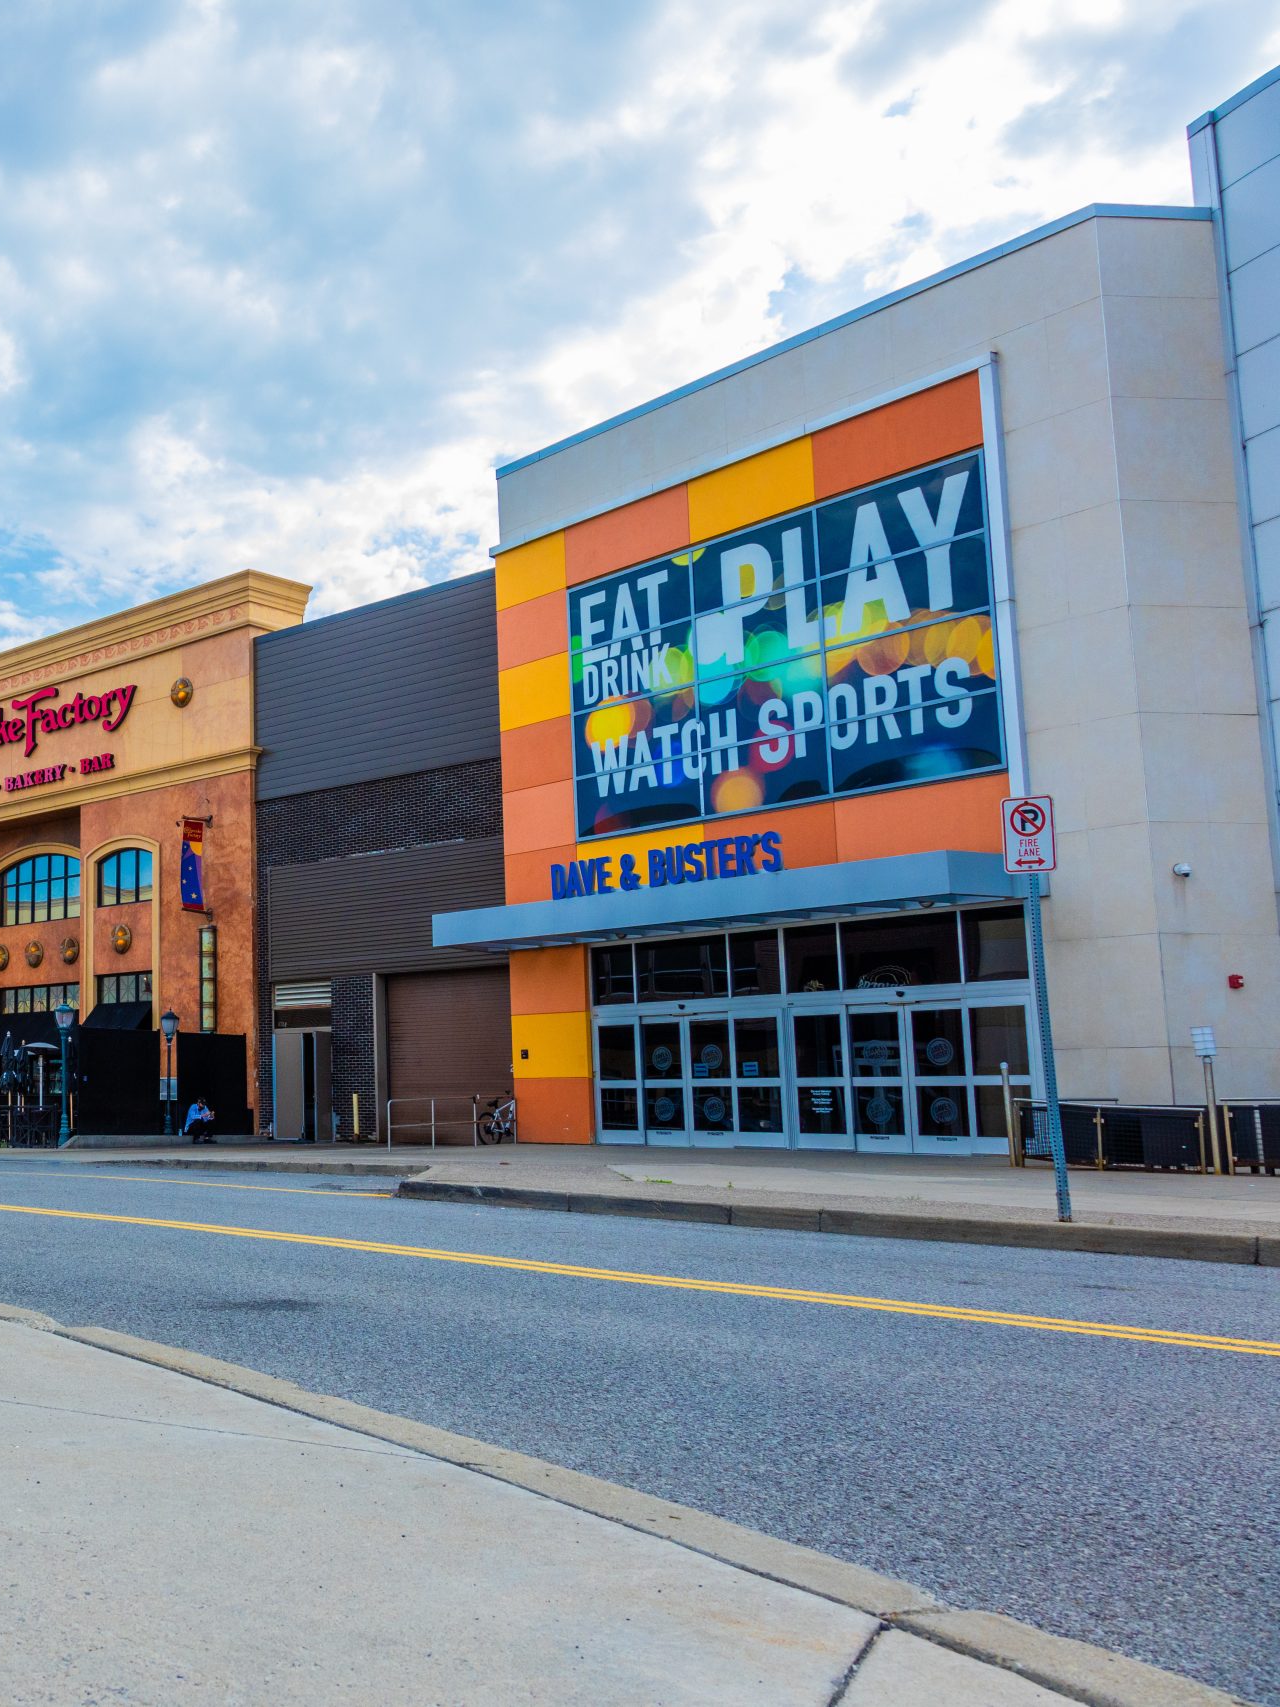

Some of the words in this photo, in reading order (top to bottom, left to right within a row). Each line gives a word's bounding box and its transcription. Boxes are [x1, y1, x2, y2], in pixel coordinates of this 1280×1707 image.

[721, 471, 969, 666] PLAY
[580, 569, 668, 665] EAT
[583, 642, 673, 706] DRINK
[12, 685, 137, 757] Factory
[592, 708, 739, 798] WATCH
[758, 657, 972, 764] SPORTS
[4, 764, 67, 792] BAKERY
[80, 753, 115, 775] BAR
[551, 856, 615, 900] DAVE
[620, 854, 642, 891] &
[648, 831, 784, 888] BUSTER'S
[1018, 847, 1041, 857] LANE
[1019, 838, 1039, 848] FIRE
